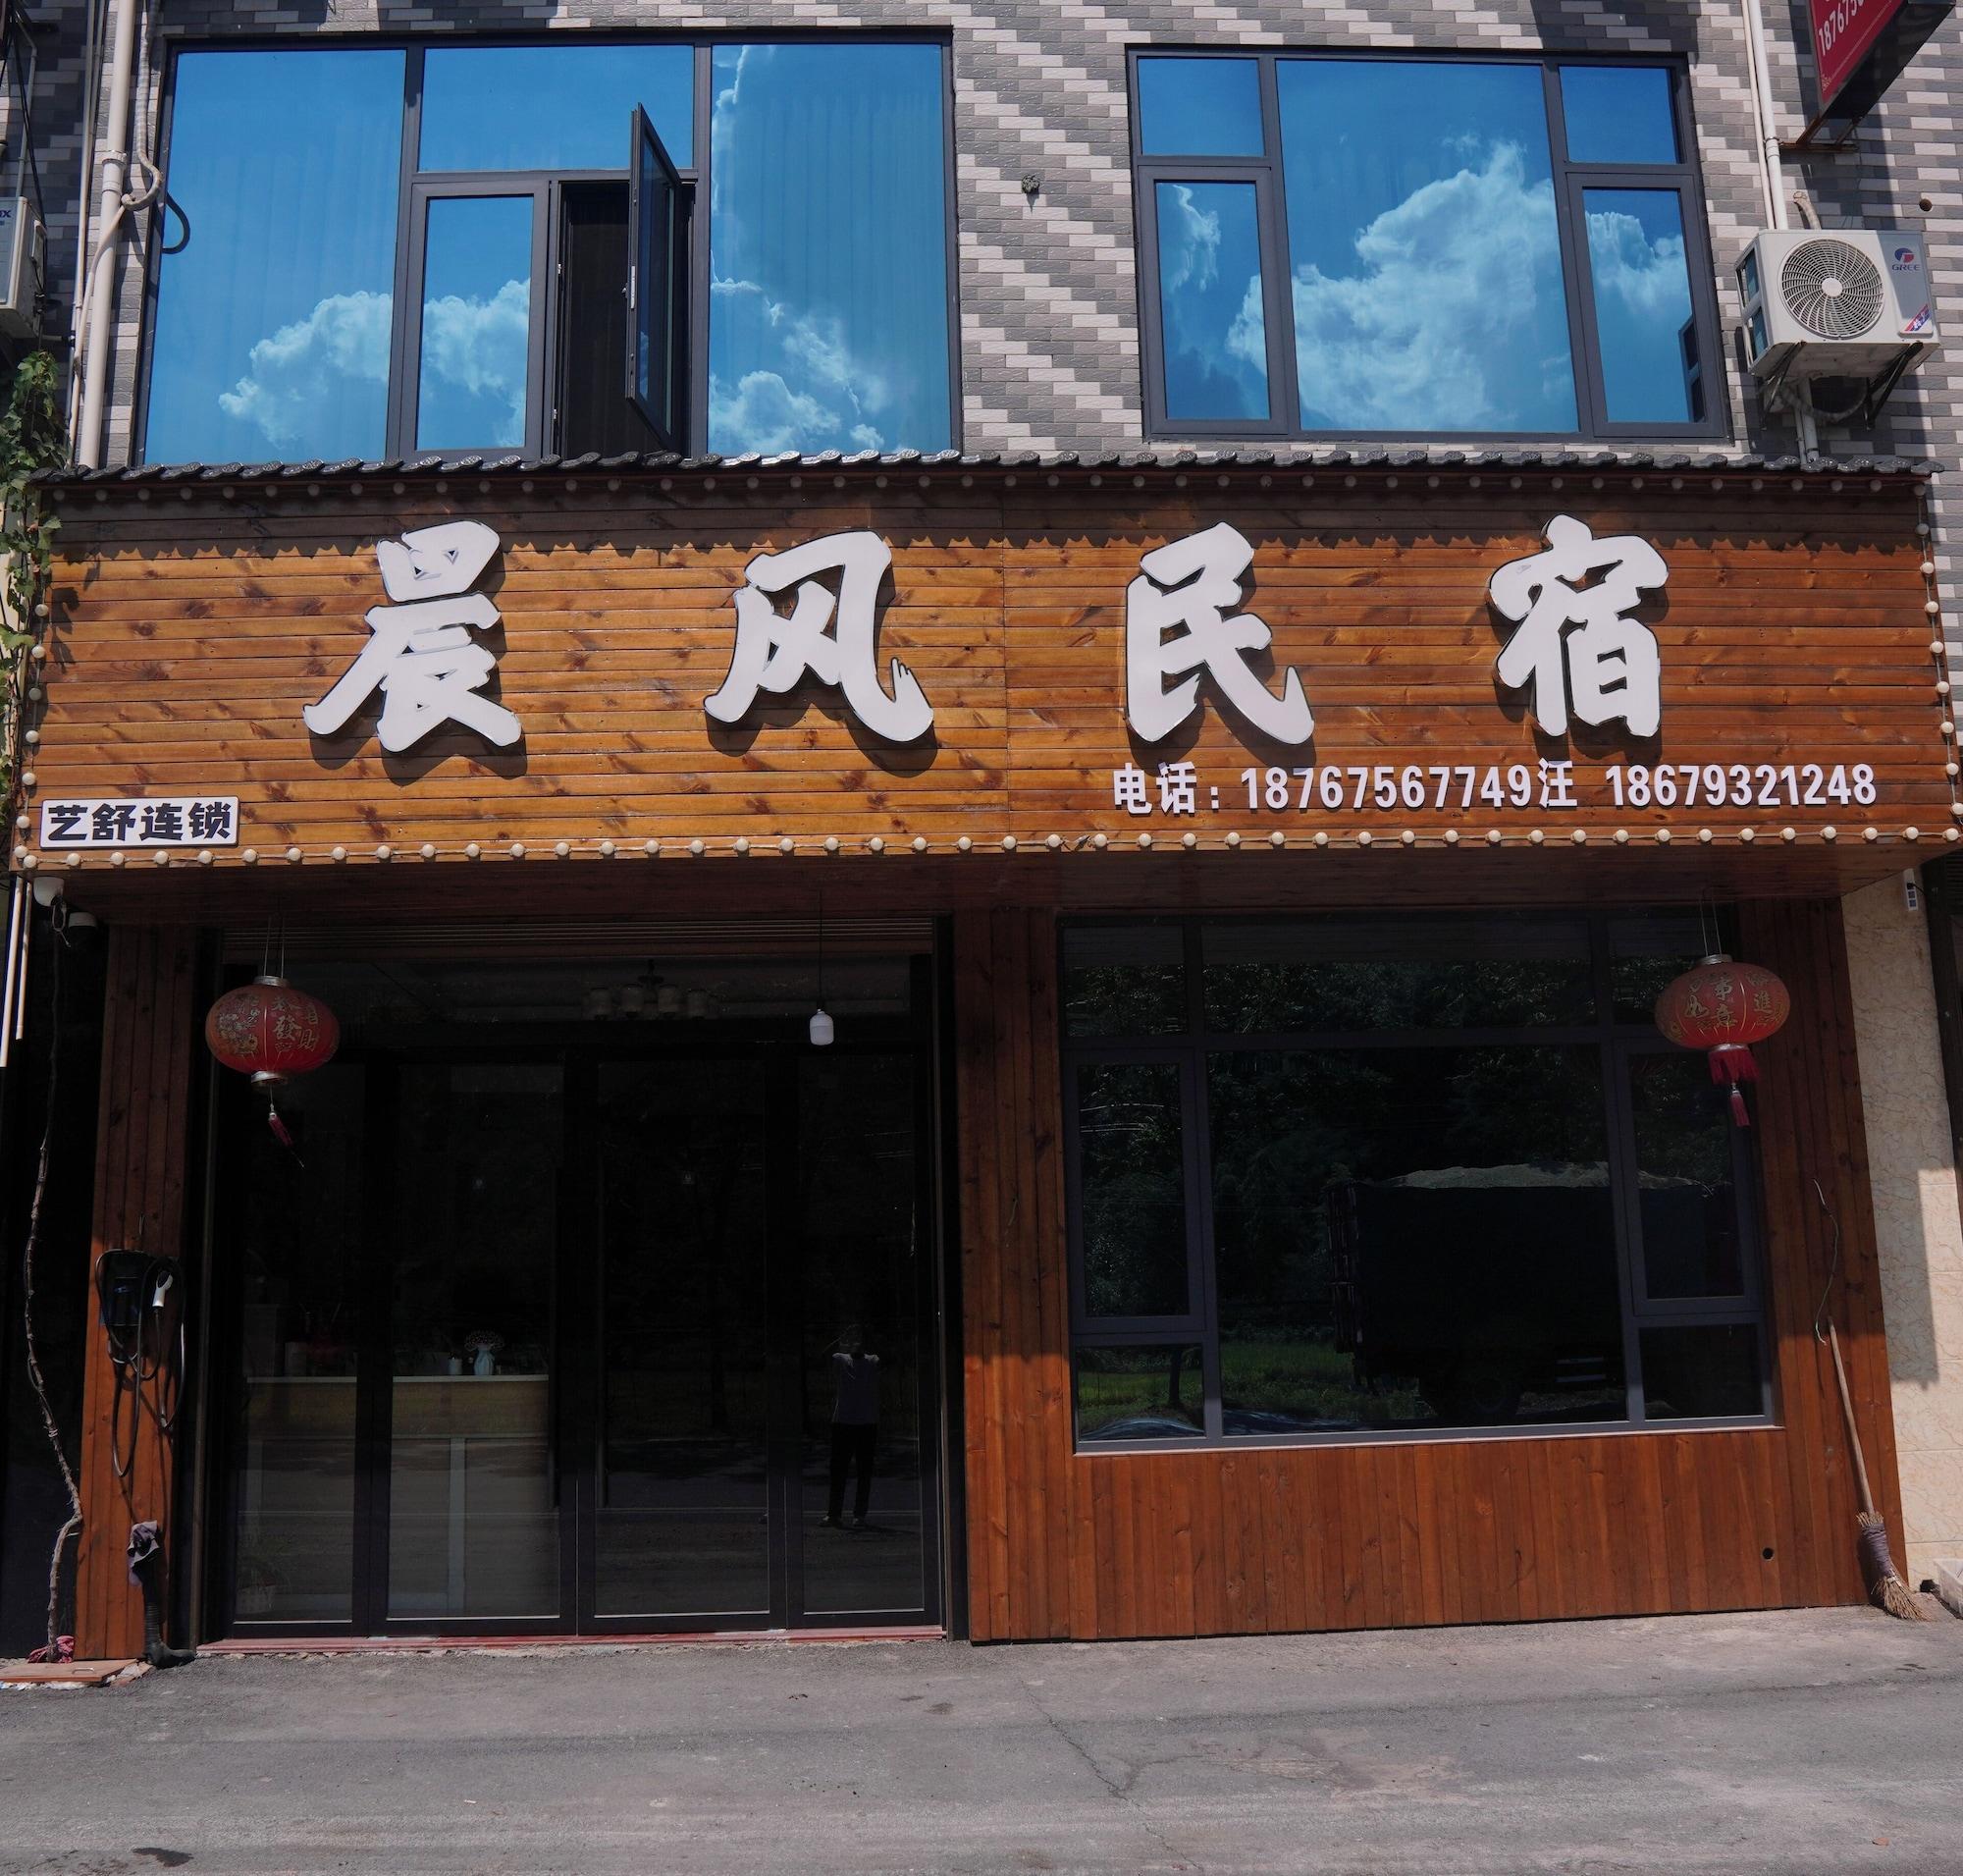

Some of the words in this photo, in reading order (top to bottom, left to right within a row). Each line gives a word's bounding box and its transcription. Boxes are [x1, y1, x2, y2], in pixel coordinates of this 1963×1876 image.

[1891, 263, 1921, 272] GREE
[303, 512, 1669, 752] 晨风民宿
[1605, 763, 1877, 807] 18679321248
[47, 801, 233, 841] 艺舒连锁
